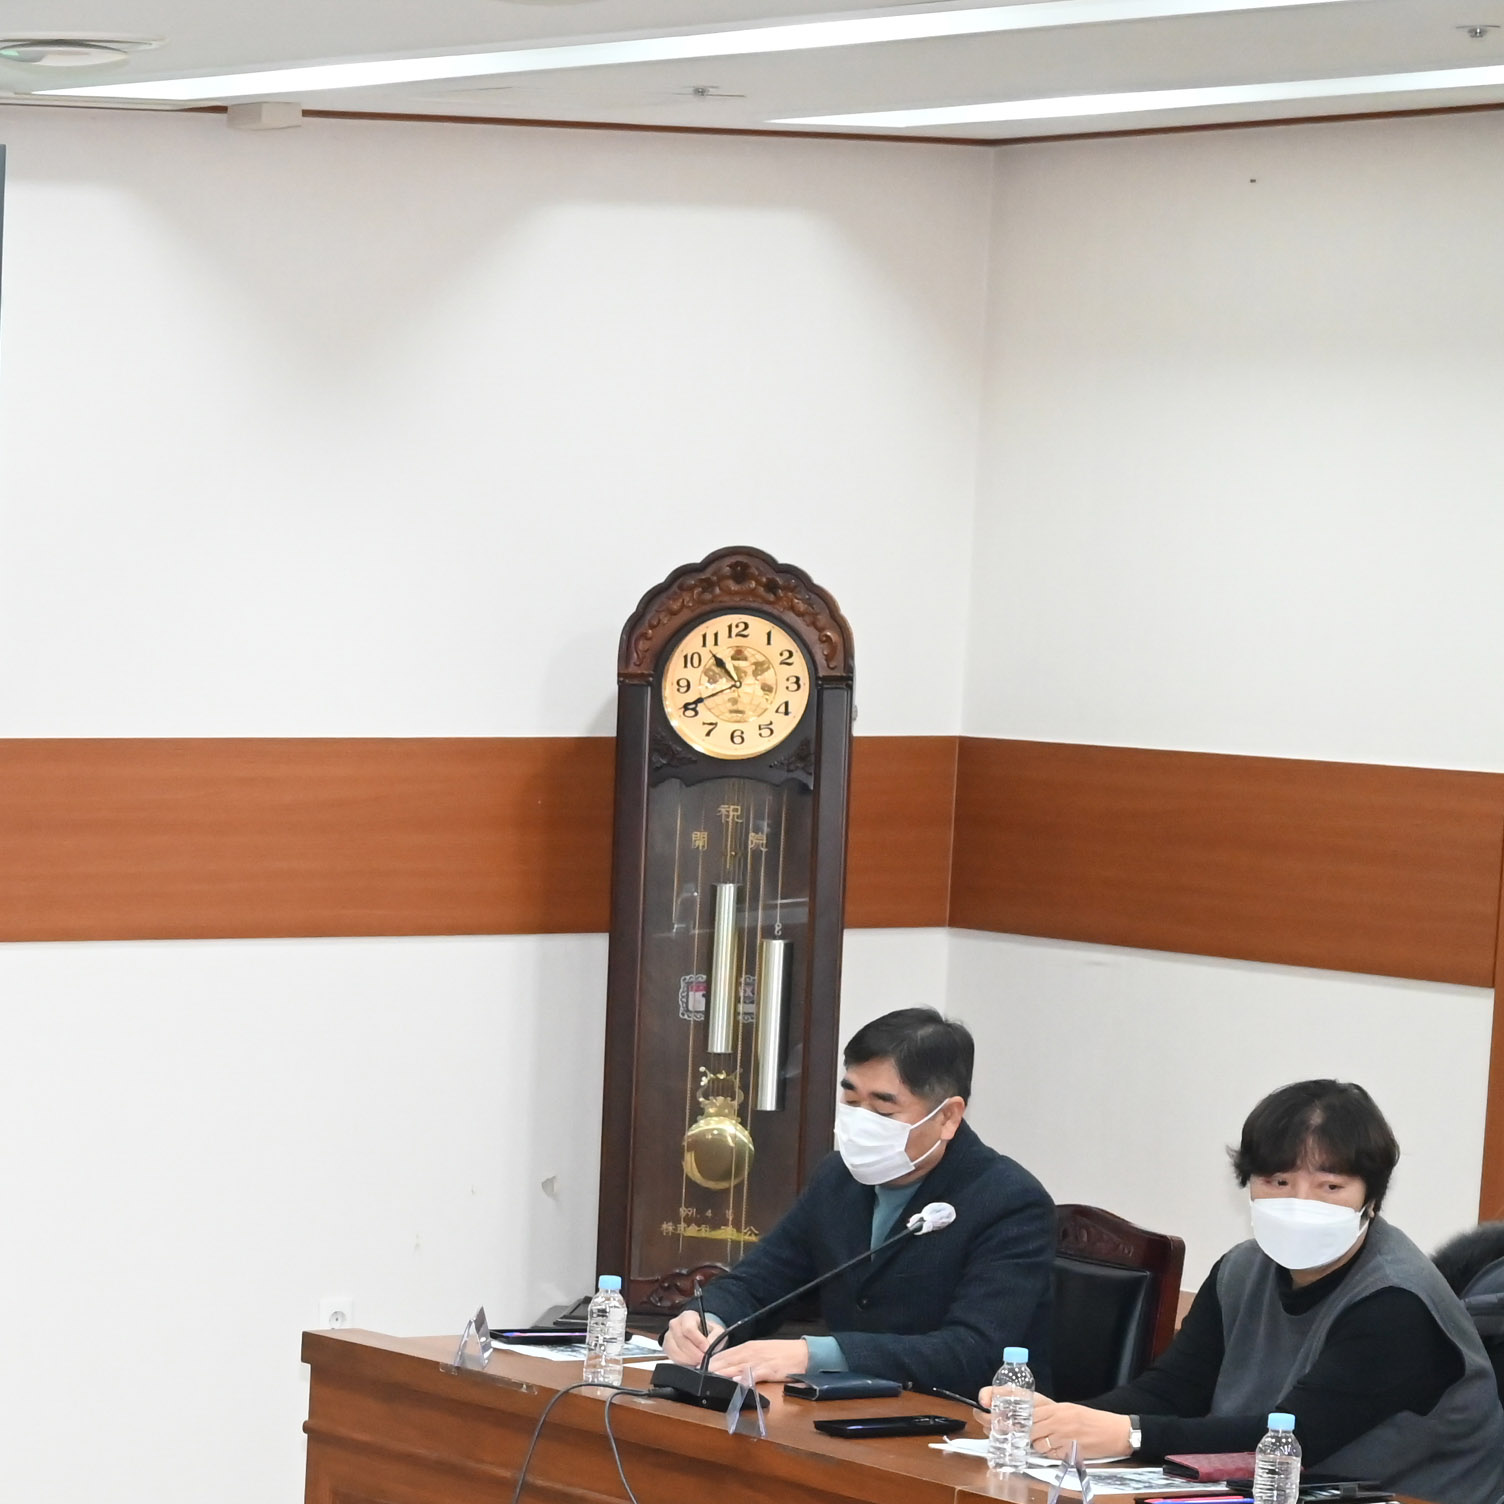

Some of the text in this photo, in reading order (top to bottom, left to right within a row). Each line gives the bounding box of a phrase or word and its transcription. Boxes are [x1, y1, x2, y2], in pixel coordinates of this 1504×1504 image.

[727, 622, 750, 639] 12
[765, 630, 773, 646] 1
[701, 632, 719, 648] 11
[683, 651, 702, 669] 10
[779, 650, 795, 667] 2
[676, 678, 691, 694] 9
[786, 675, 802, 693] 3
[682, 702, 700, 718] 8
[775, 701, 792, 717] 4
[702, 721, 719, 737] 7
[730, 729, 745, 745] 6
[758, 721, 775, 739] 5
